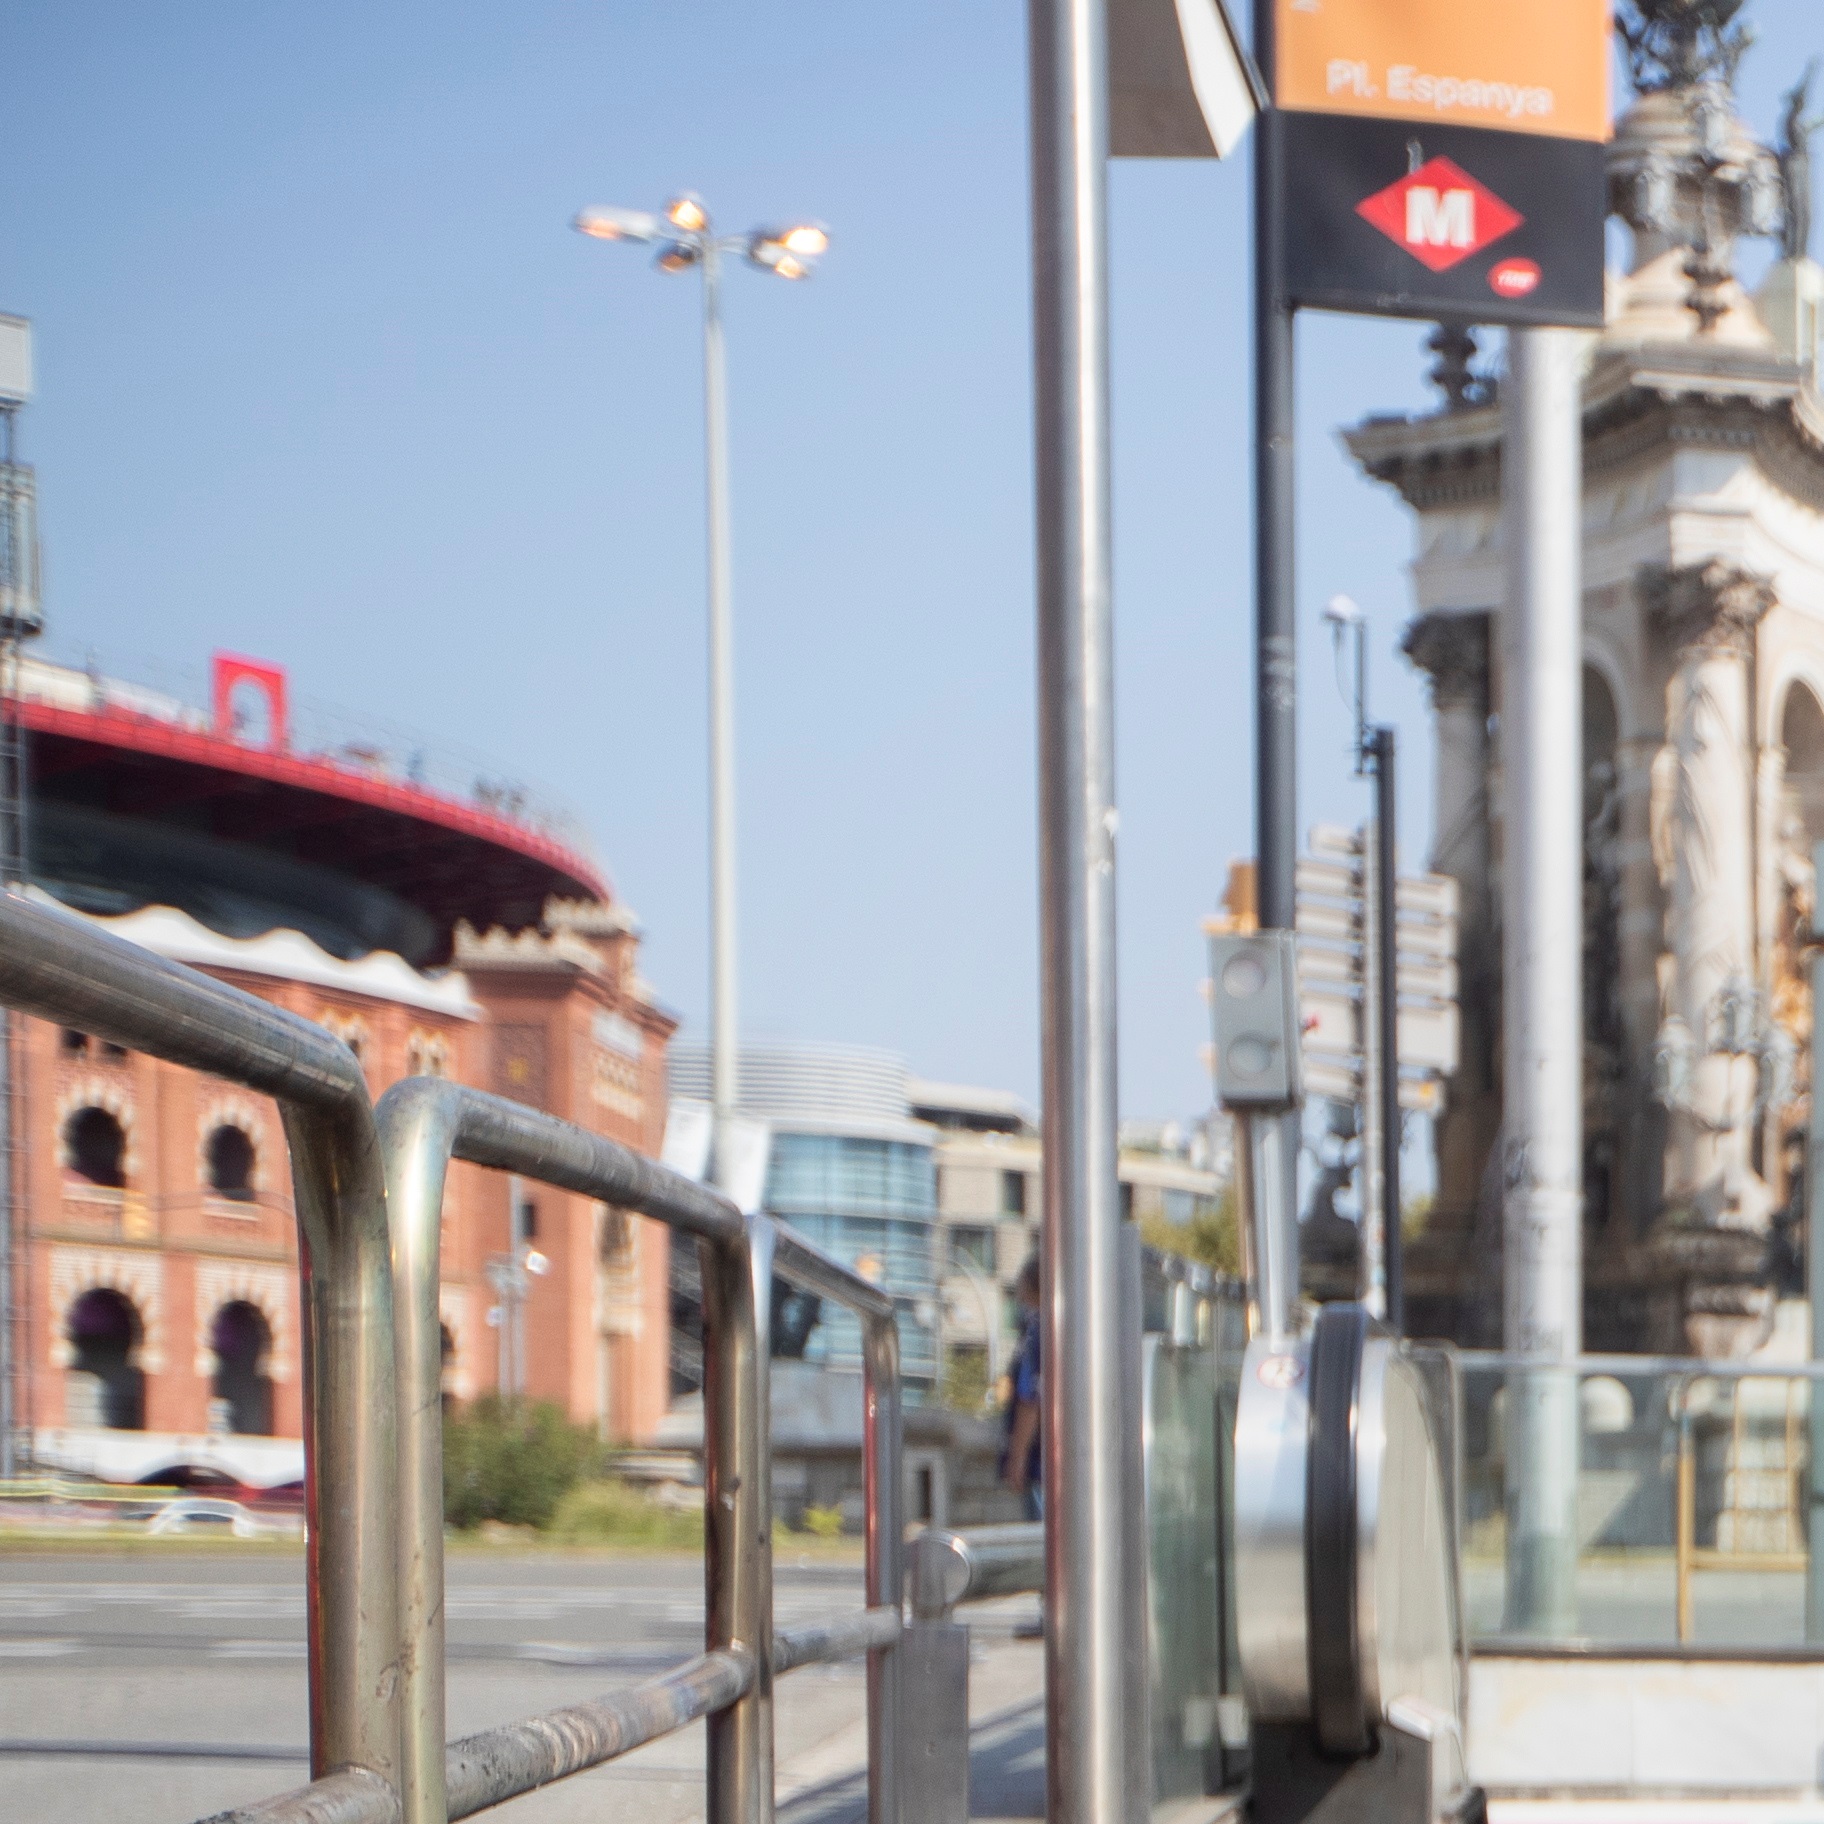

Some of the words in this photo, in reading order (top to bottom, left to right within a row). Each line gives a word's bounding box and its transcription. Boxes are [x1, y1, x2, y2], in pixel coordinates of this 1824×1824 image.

[1326, 59, 1379, 99] Pl.
[1386, 65, 1553, 117] Espanya
[1405, 186, 1476, 249] M
